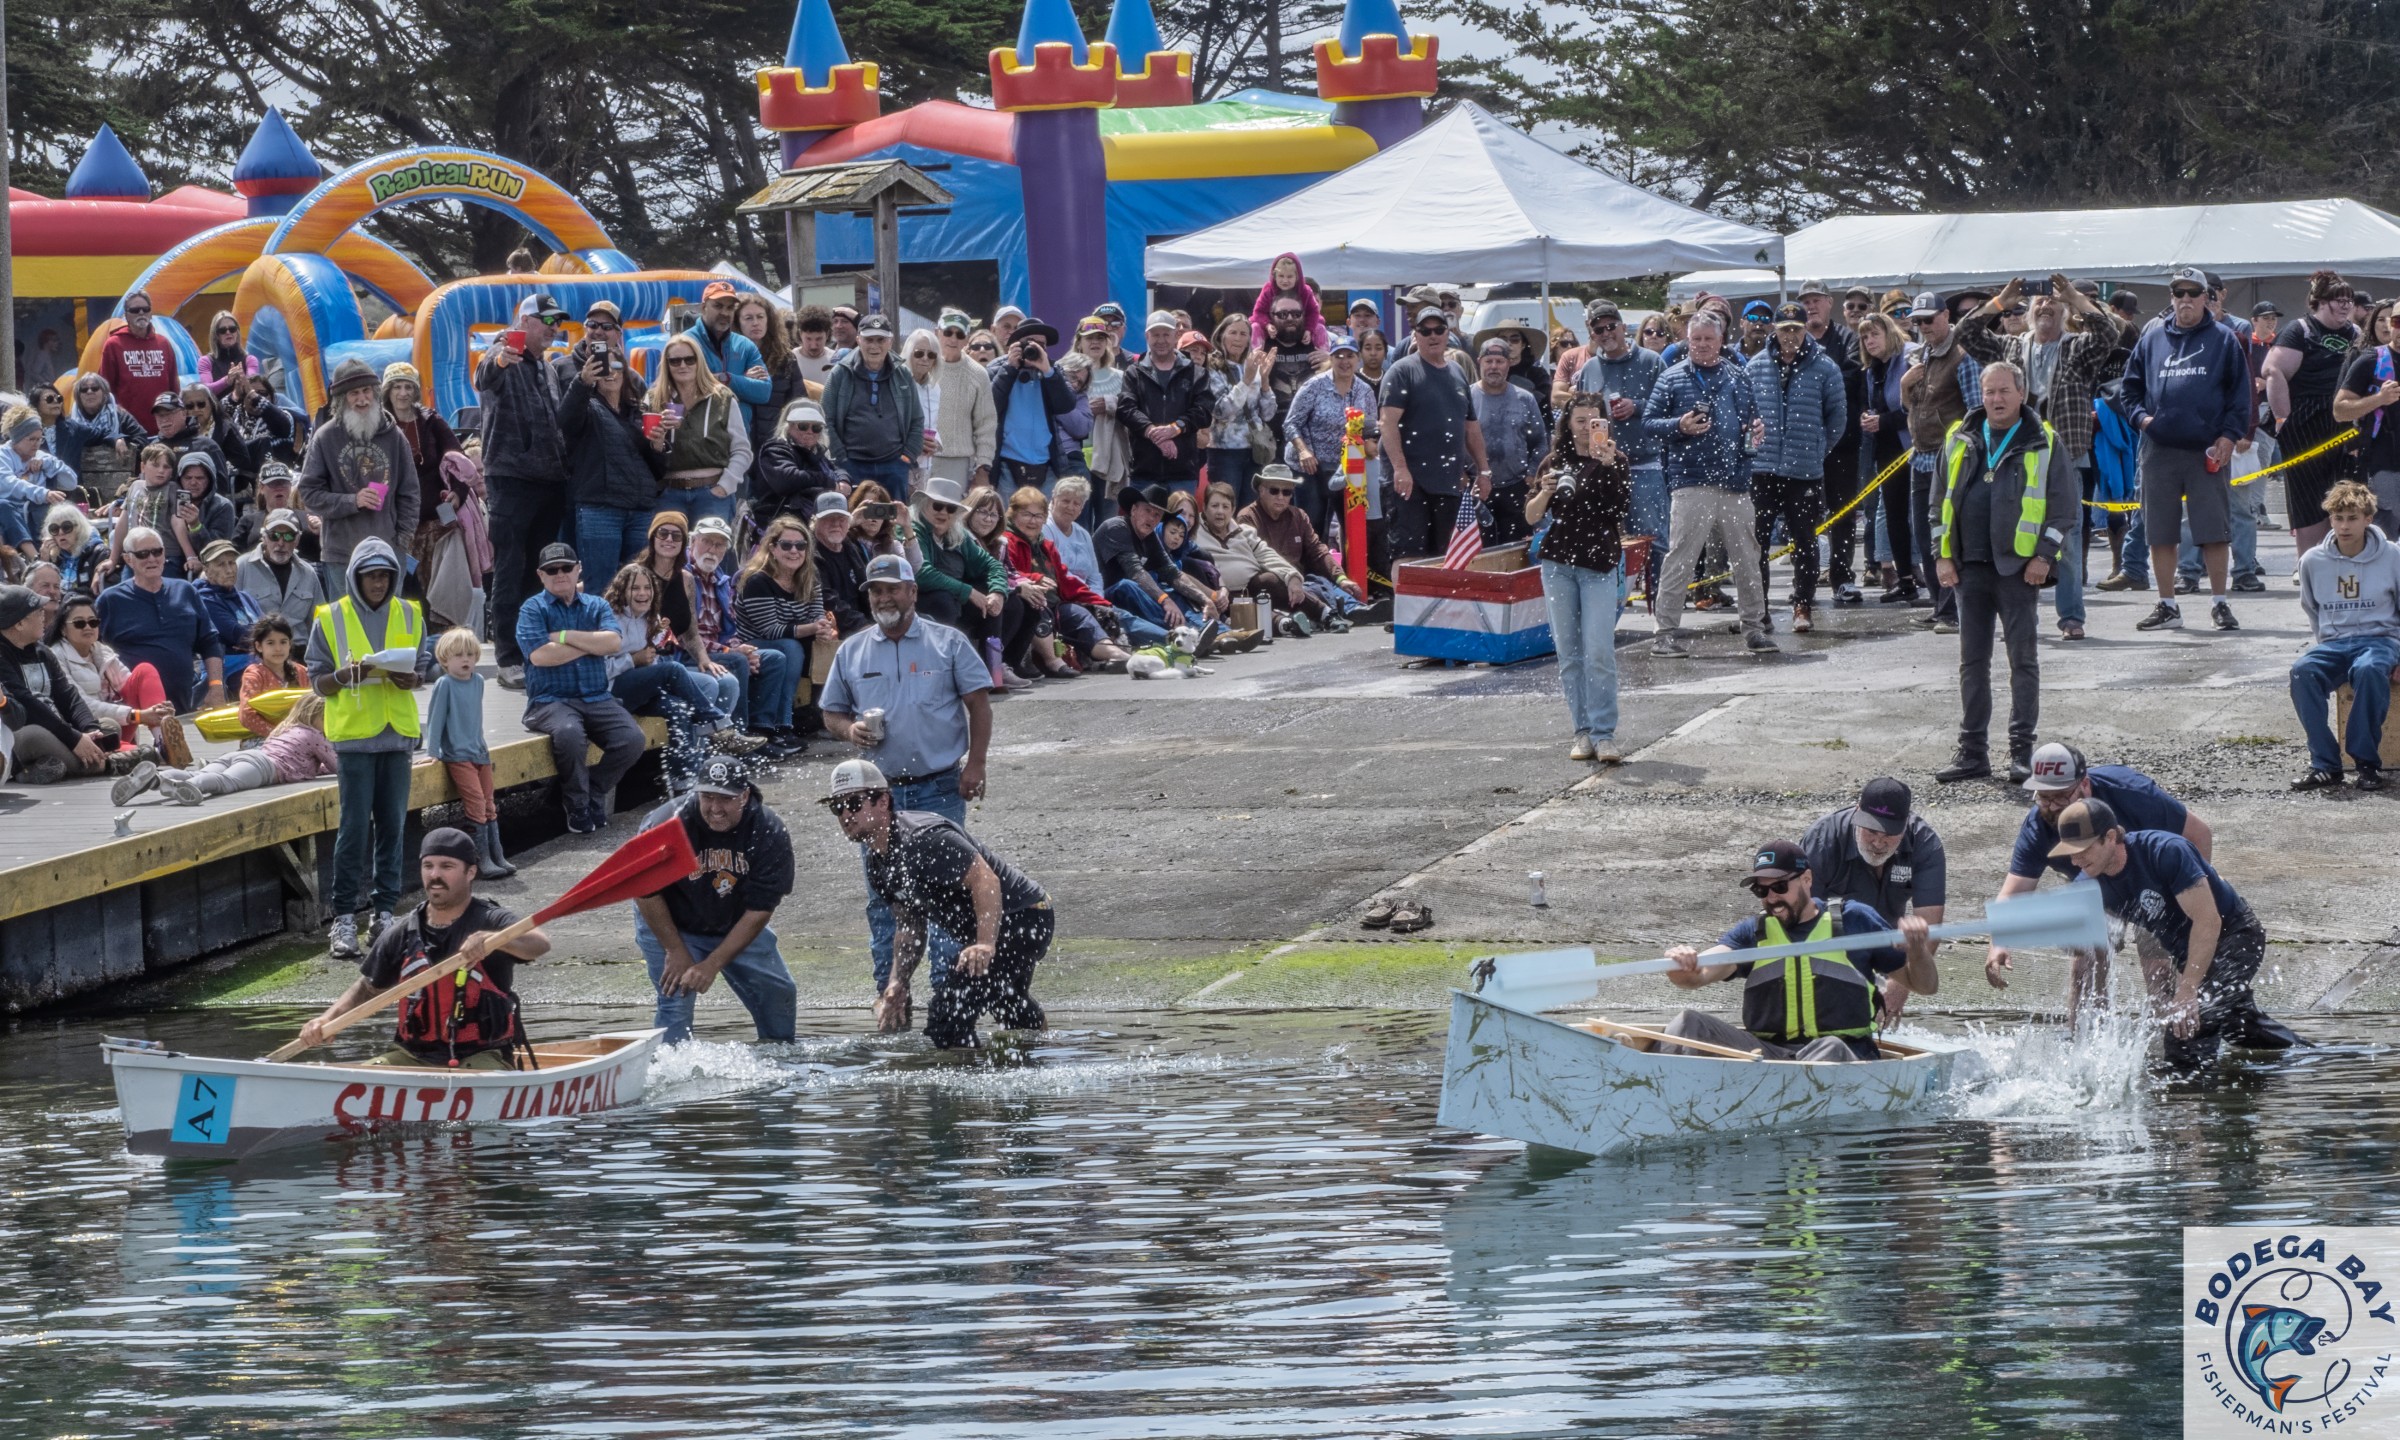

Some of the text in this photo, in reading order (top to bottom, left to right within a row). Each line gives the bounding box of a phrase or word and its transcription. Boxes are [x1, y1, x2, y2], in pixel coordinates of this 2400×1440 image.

[123, 350, 165, 365] CHICO STATE
[2159, 366, 2207, 378] JUST HOOK IT.
[2336, 575, 2360, 599] NU
[2323, 601, 2376, 610] BASKETBALL
[2034, 761, 2068, 776] UFC
[188, 1077, 217, 1141] A7
